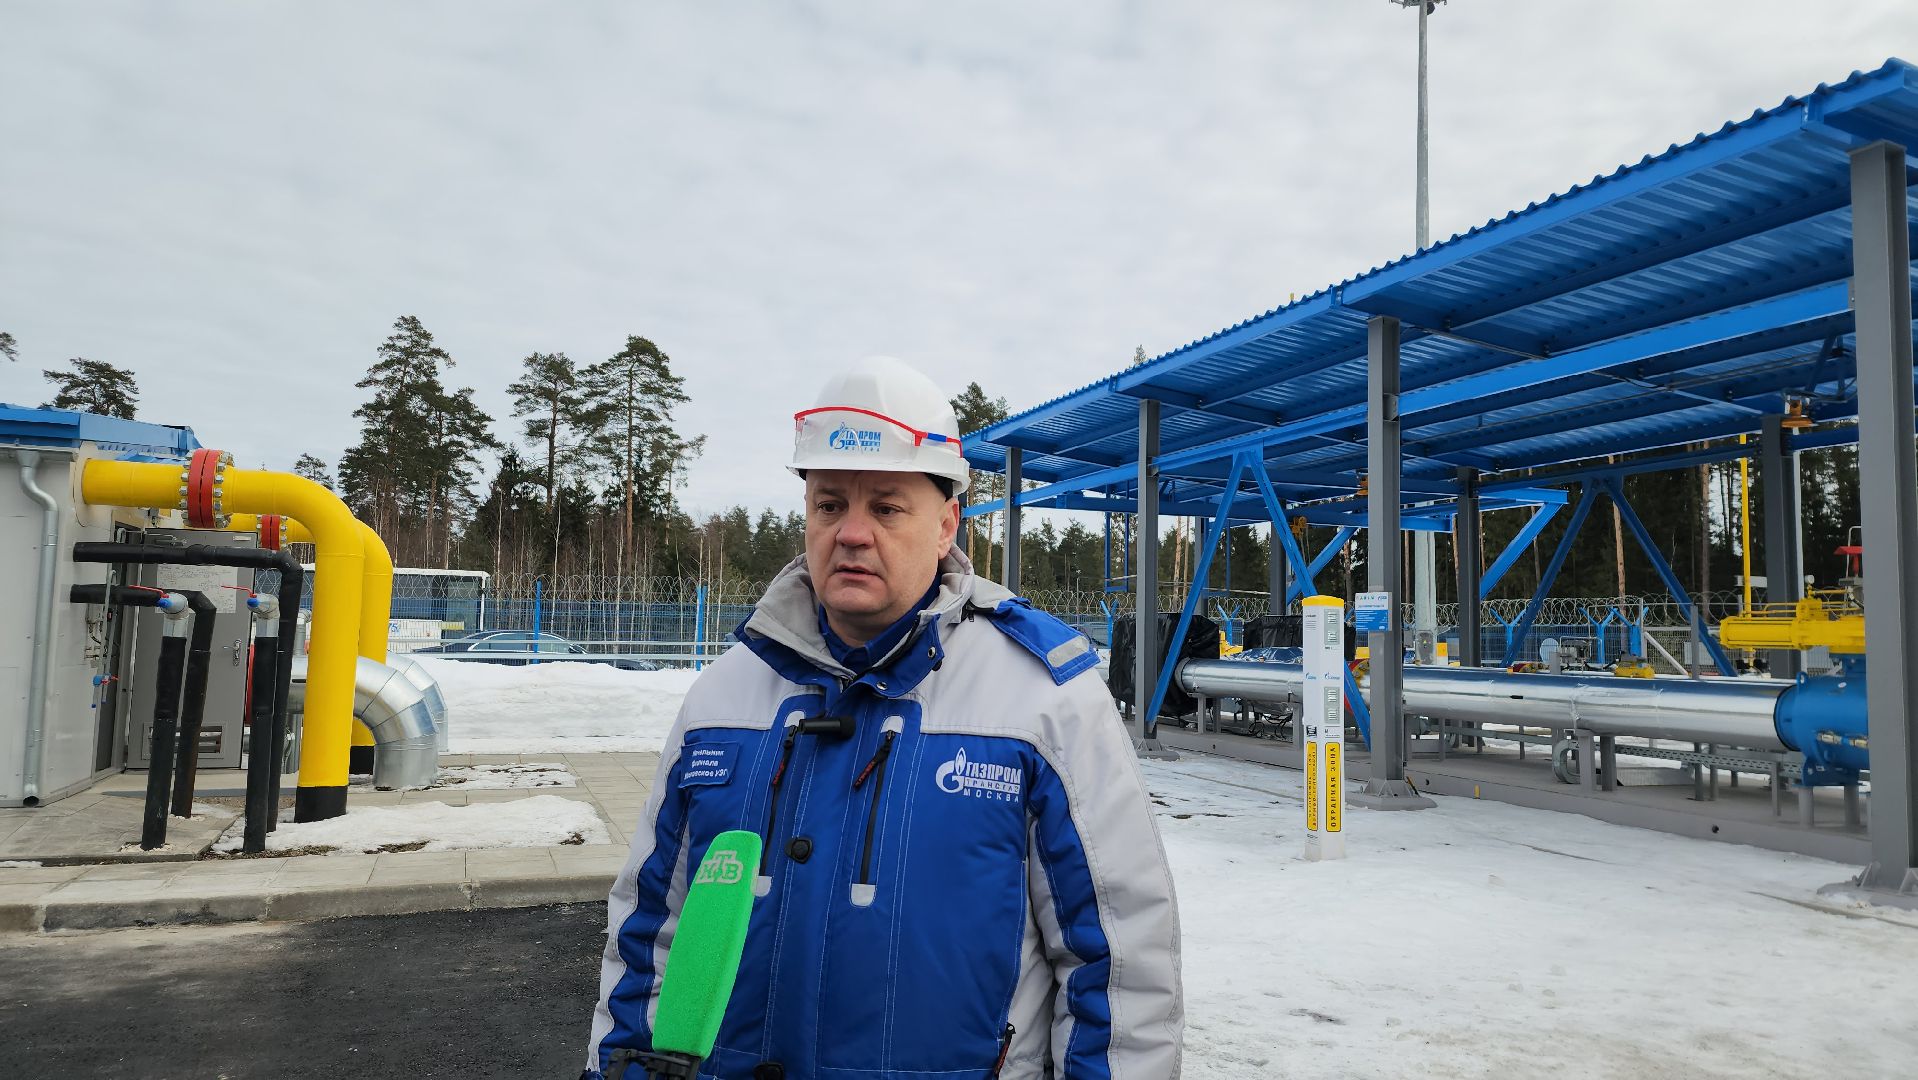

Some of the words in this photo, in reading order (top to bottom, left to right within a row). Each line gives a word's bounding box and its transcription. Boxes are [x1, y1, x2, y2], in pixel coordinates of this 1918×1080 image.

[965, 762, 1021, 784] ГАЗПРОМ
[965, 778, 1020, 793] ТРАНСГАЗ
[963, 788, 1019, 803] МОСКВА
[697, 851, 742, 883] НТВ
